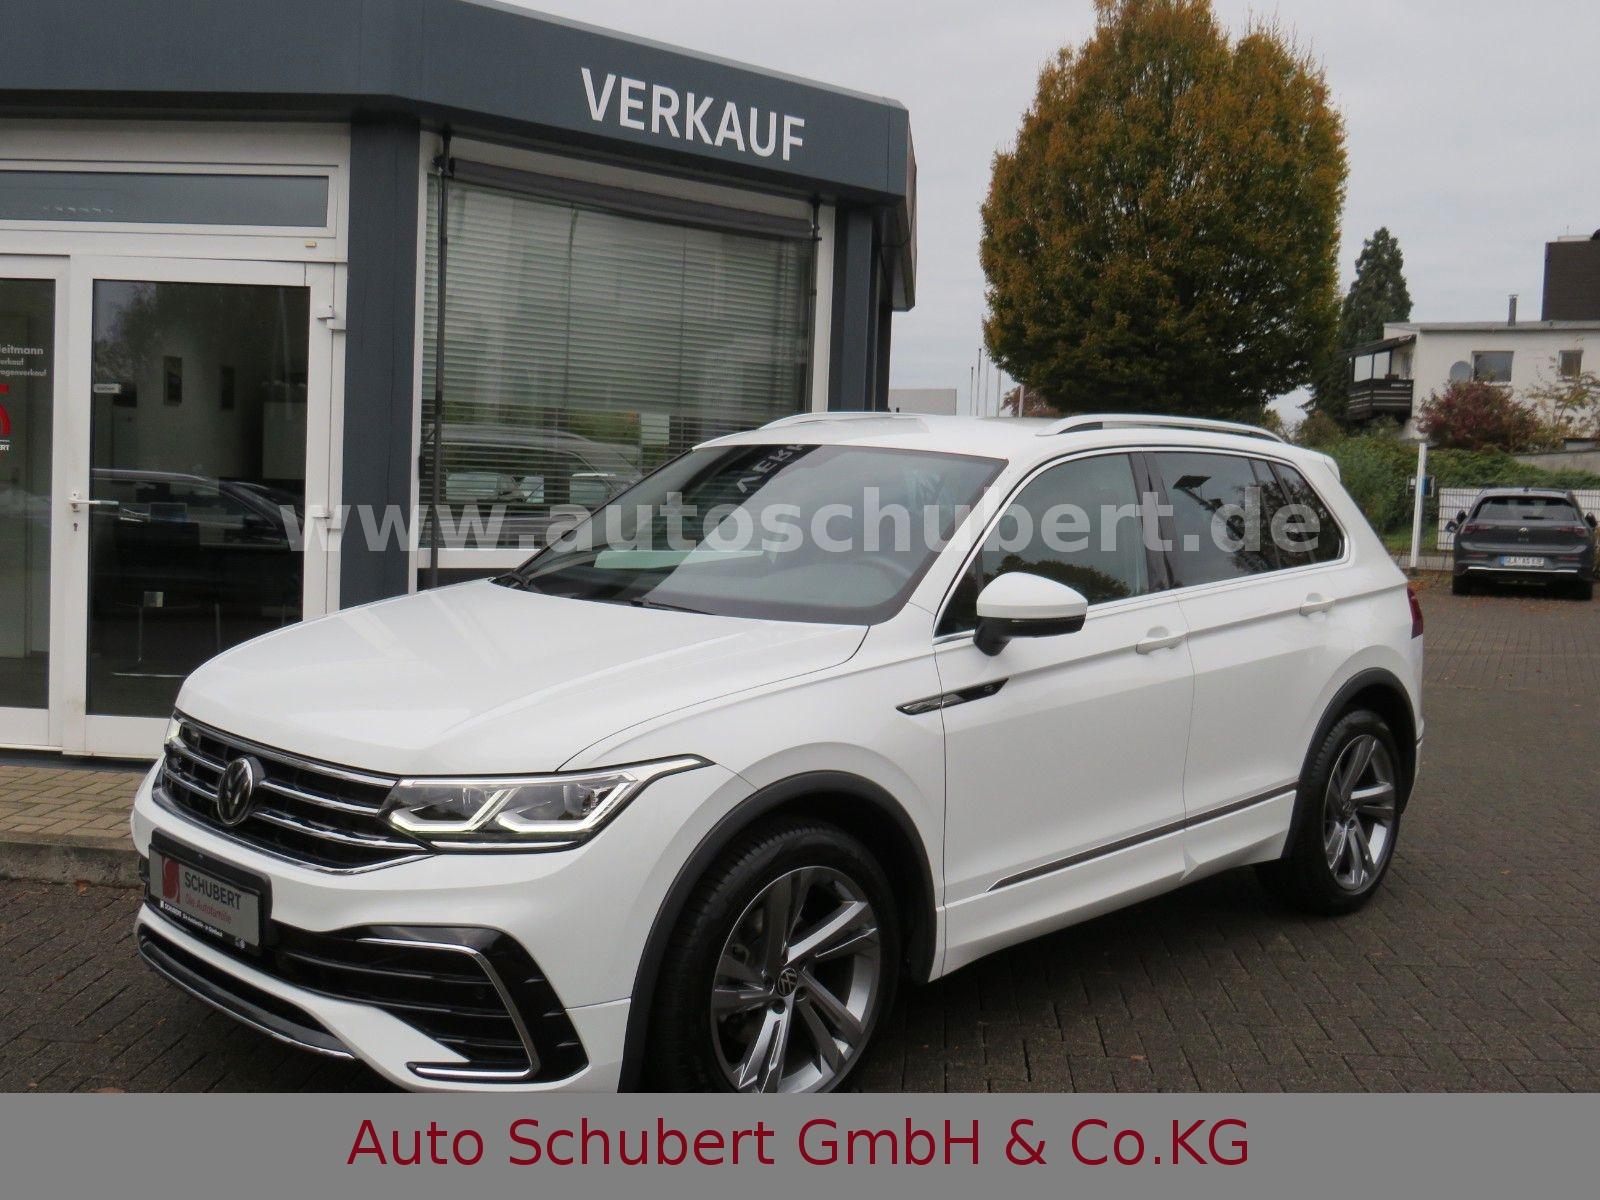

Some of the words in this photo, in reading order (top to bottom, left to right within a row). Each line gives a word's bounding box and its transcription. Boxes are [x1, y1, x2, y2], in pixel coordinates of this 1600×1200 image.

[581, 67, 805, 161] VERKAUF
[0, 344, 44, 355] eitmann
[184, 871, 241, 910] SCHUBERT
